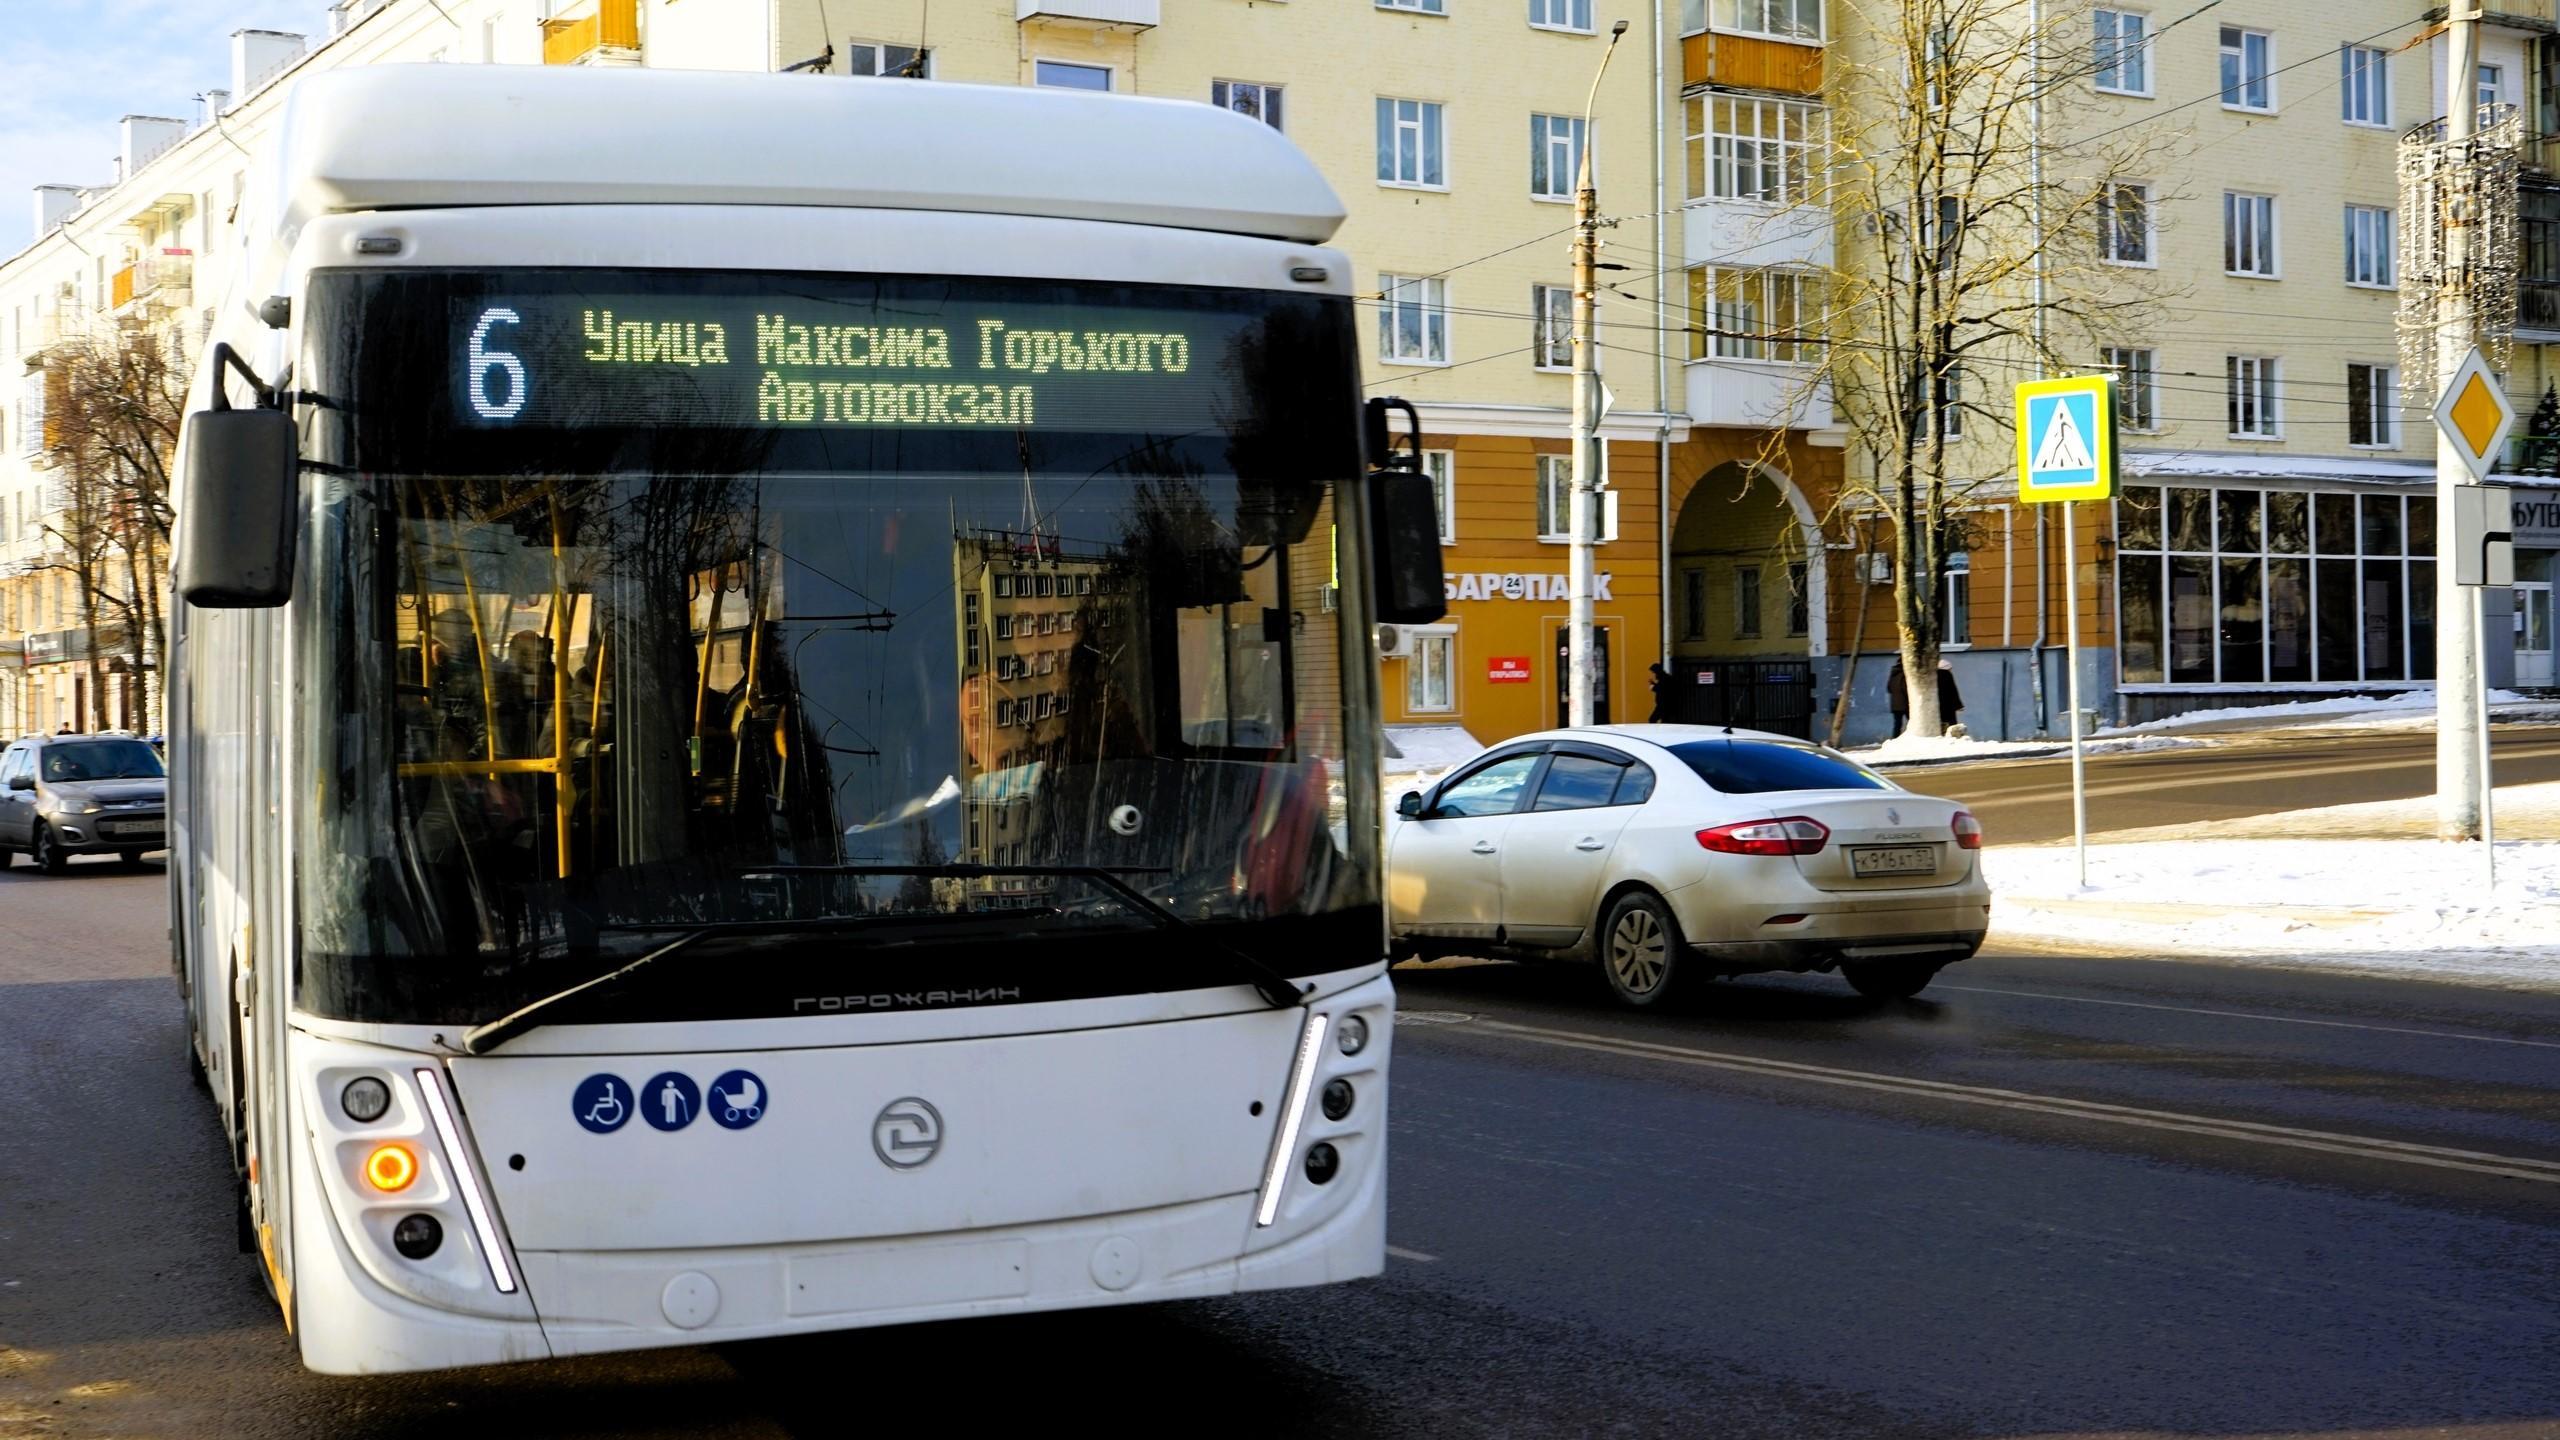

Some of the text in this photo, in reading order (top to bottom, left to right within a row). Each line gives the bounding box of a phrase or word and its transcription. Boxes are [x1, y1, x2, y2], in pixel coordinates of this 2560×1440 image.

[467, 307, 527, 419] 6
[583, 310, 1189, 374] Улица Максима Горького
[757, 371, 1035, 425] Автовокзал
[794, 987, 1020, 1011] ГОРОЖАНИН
